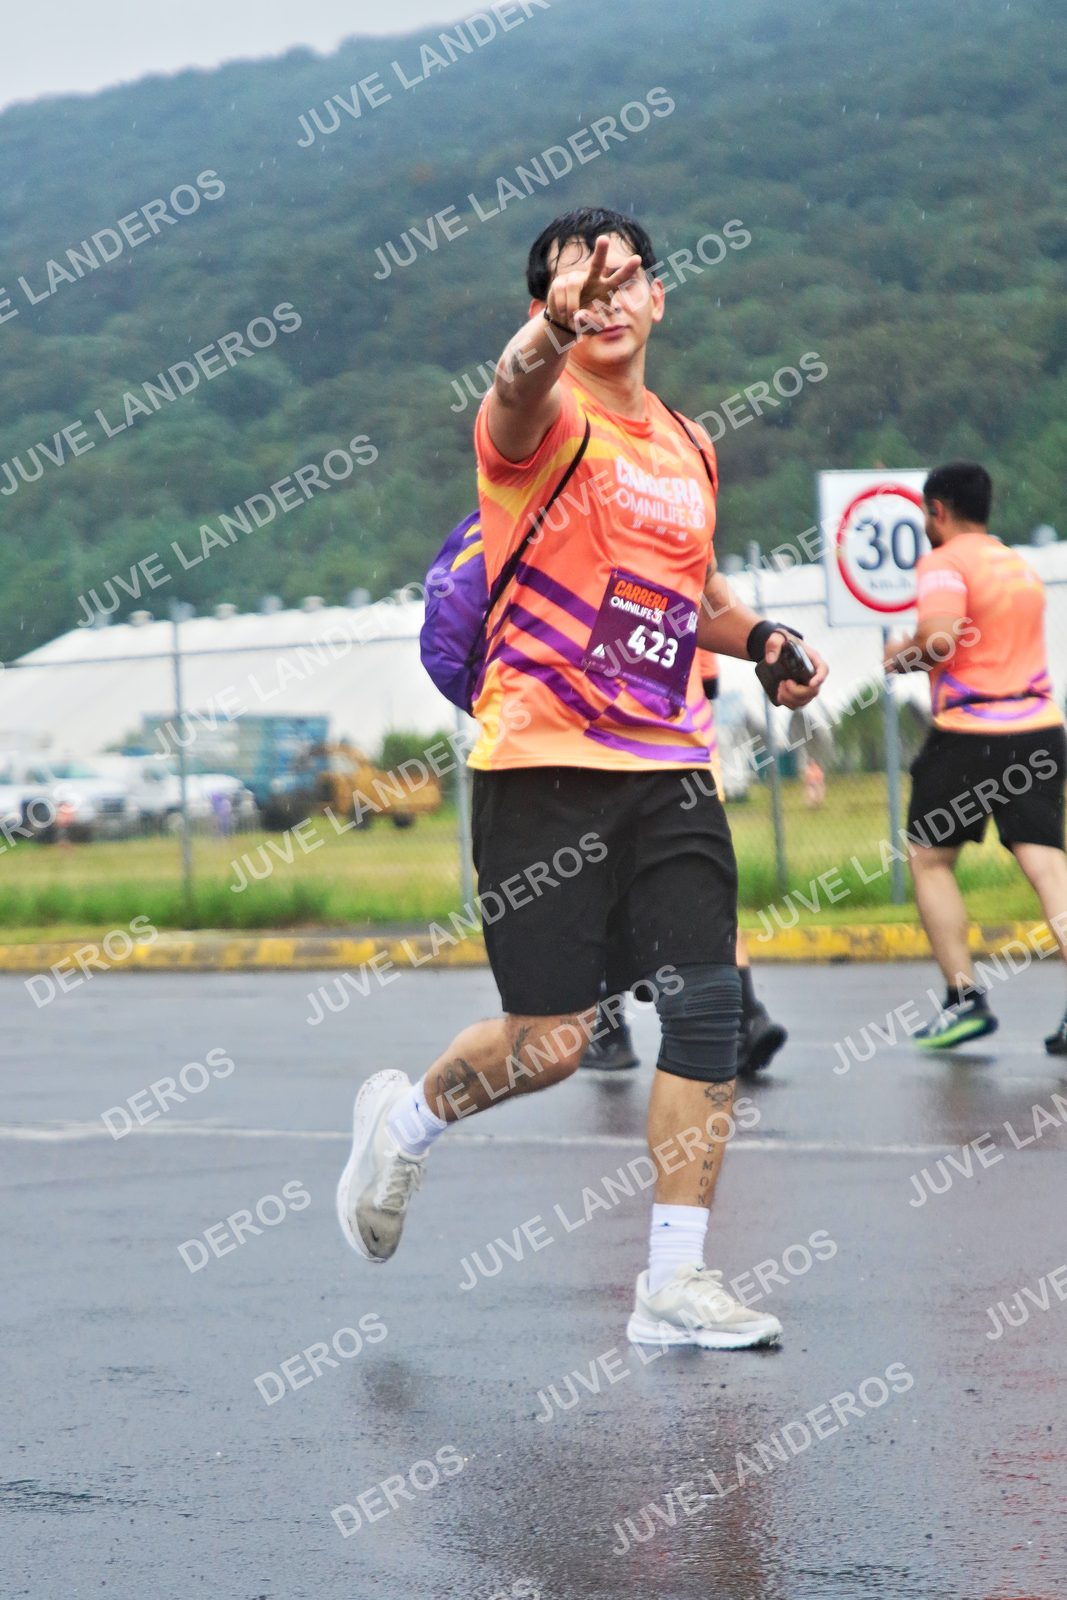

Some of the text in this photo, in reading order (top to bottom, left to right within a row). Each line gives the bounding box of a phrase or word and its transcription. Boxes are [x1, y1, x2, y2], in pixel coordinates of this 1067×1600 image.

[855, 517, 922, 571] 30
[610, 596, 654, 621] OMNILIFE
[613, 580, 669, 612] CARRERA
[627, 624, 679, 669] 423
